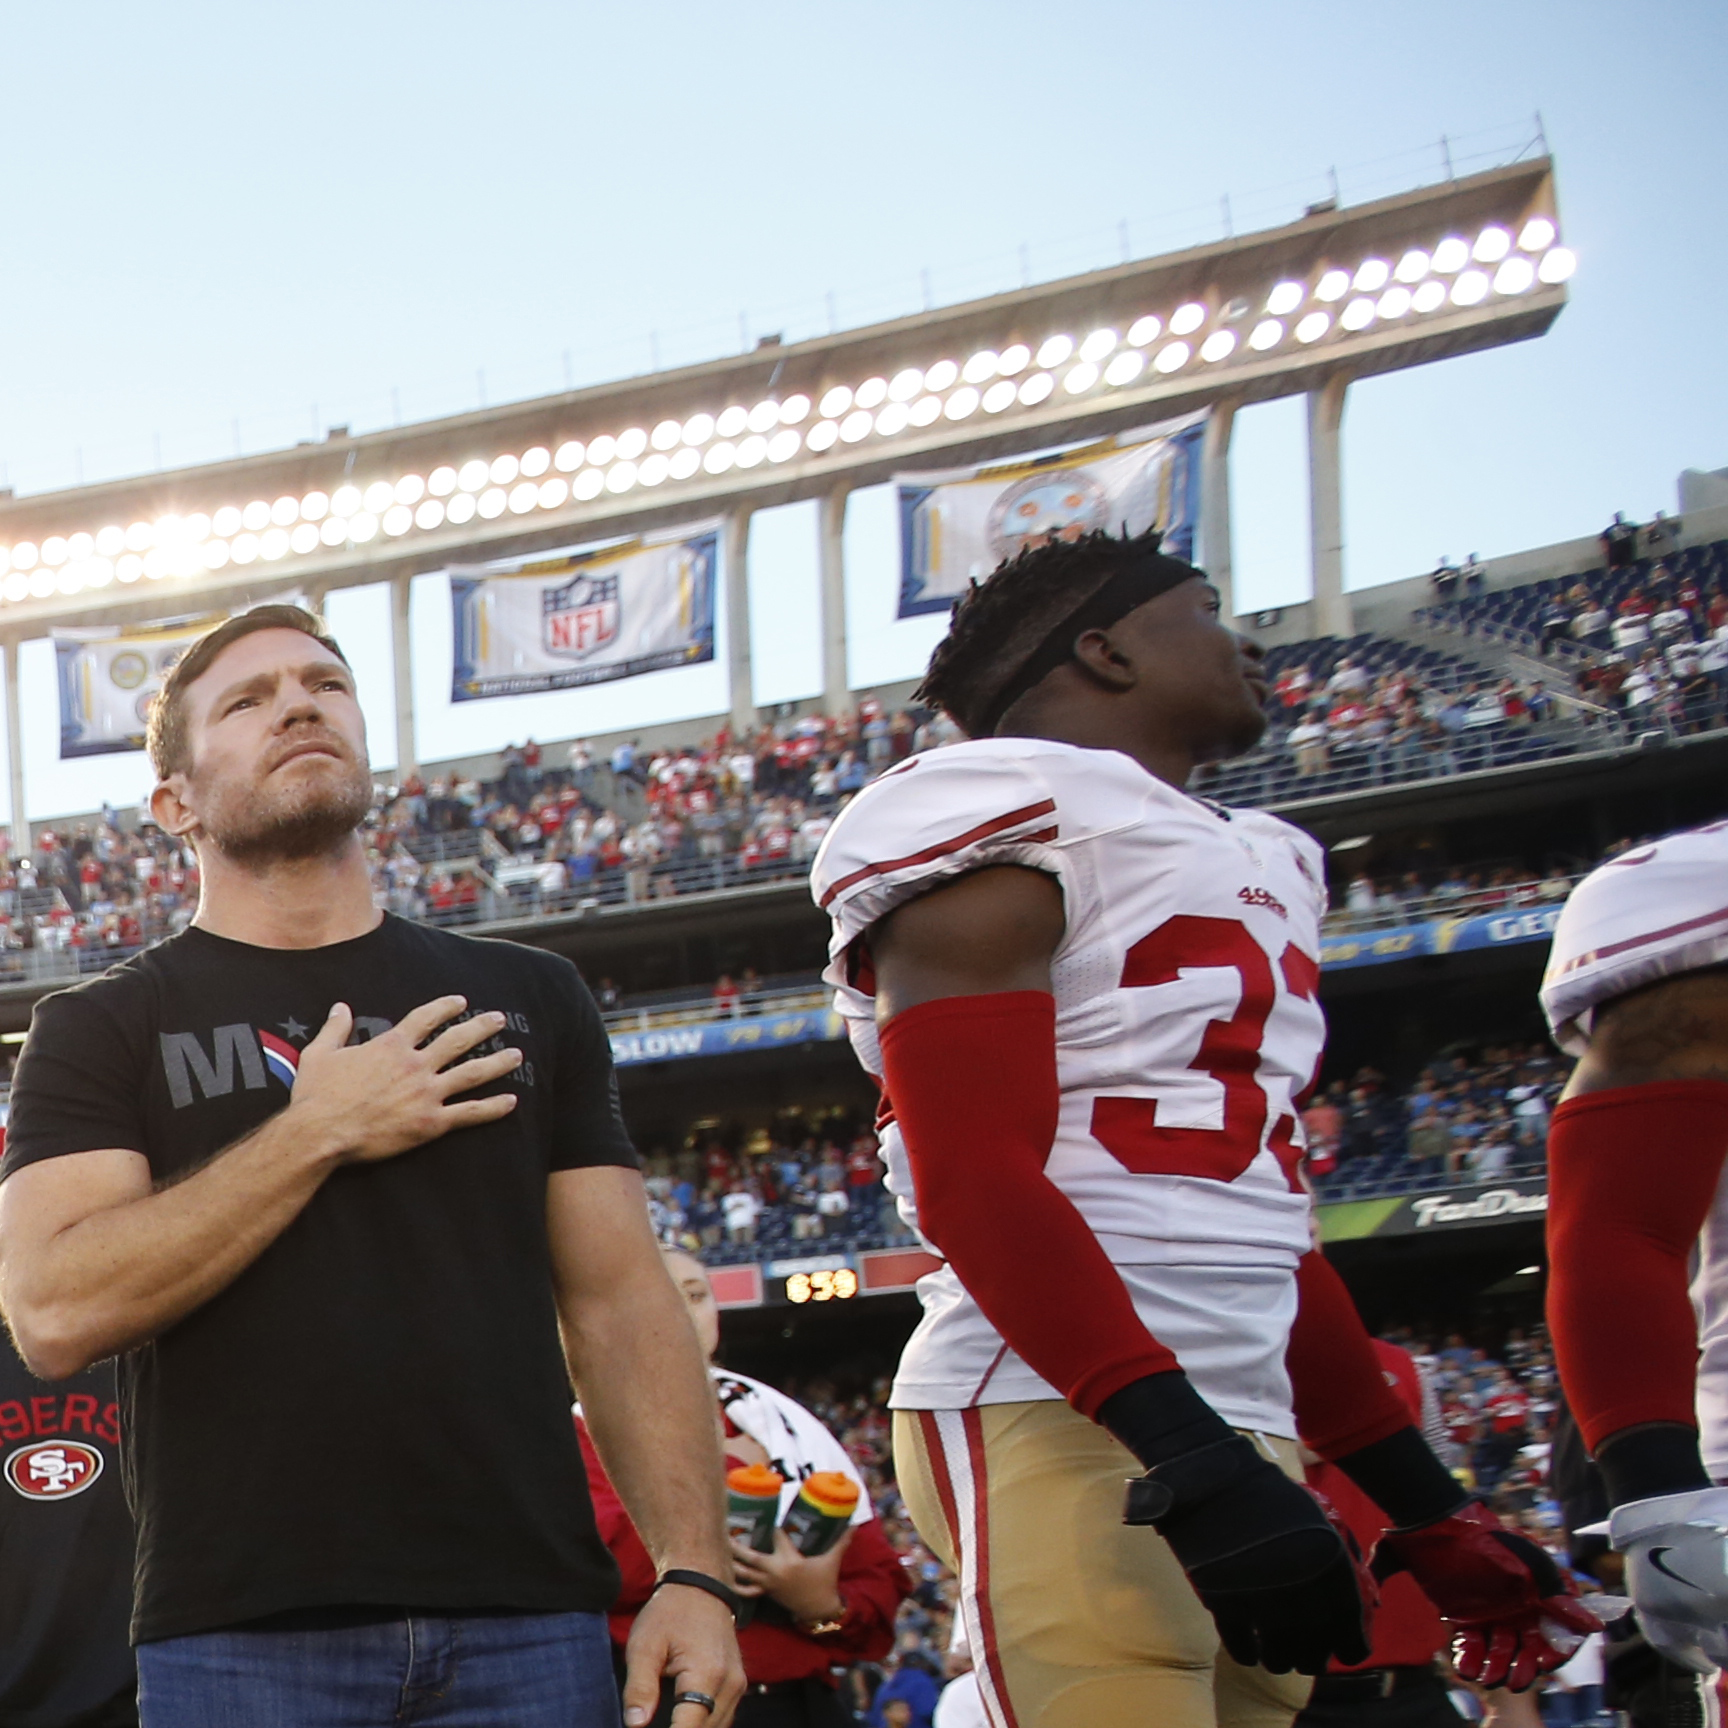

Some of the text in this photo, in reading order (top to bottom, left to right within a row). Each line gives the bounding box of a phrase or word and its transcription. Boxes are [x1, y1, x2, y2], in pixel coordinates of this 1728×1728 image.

[551, 609, 616, 650] NFL
[1090, 914, 1321, 1194] 3
[29, 1449, 85, 1492] SF
